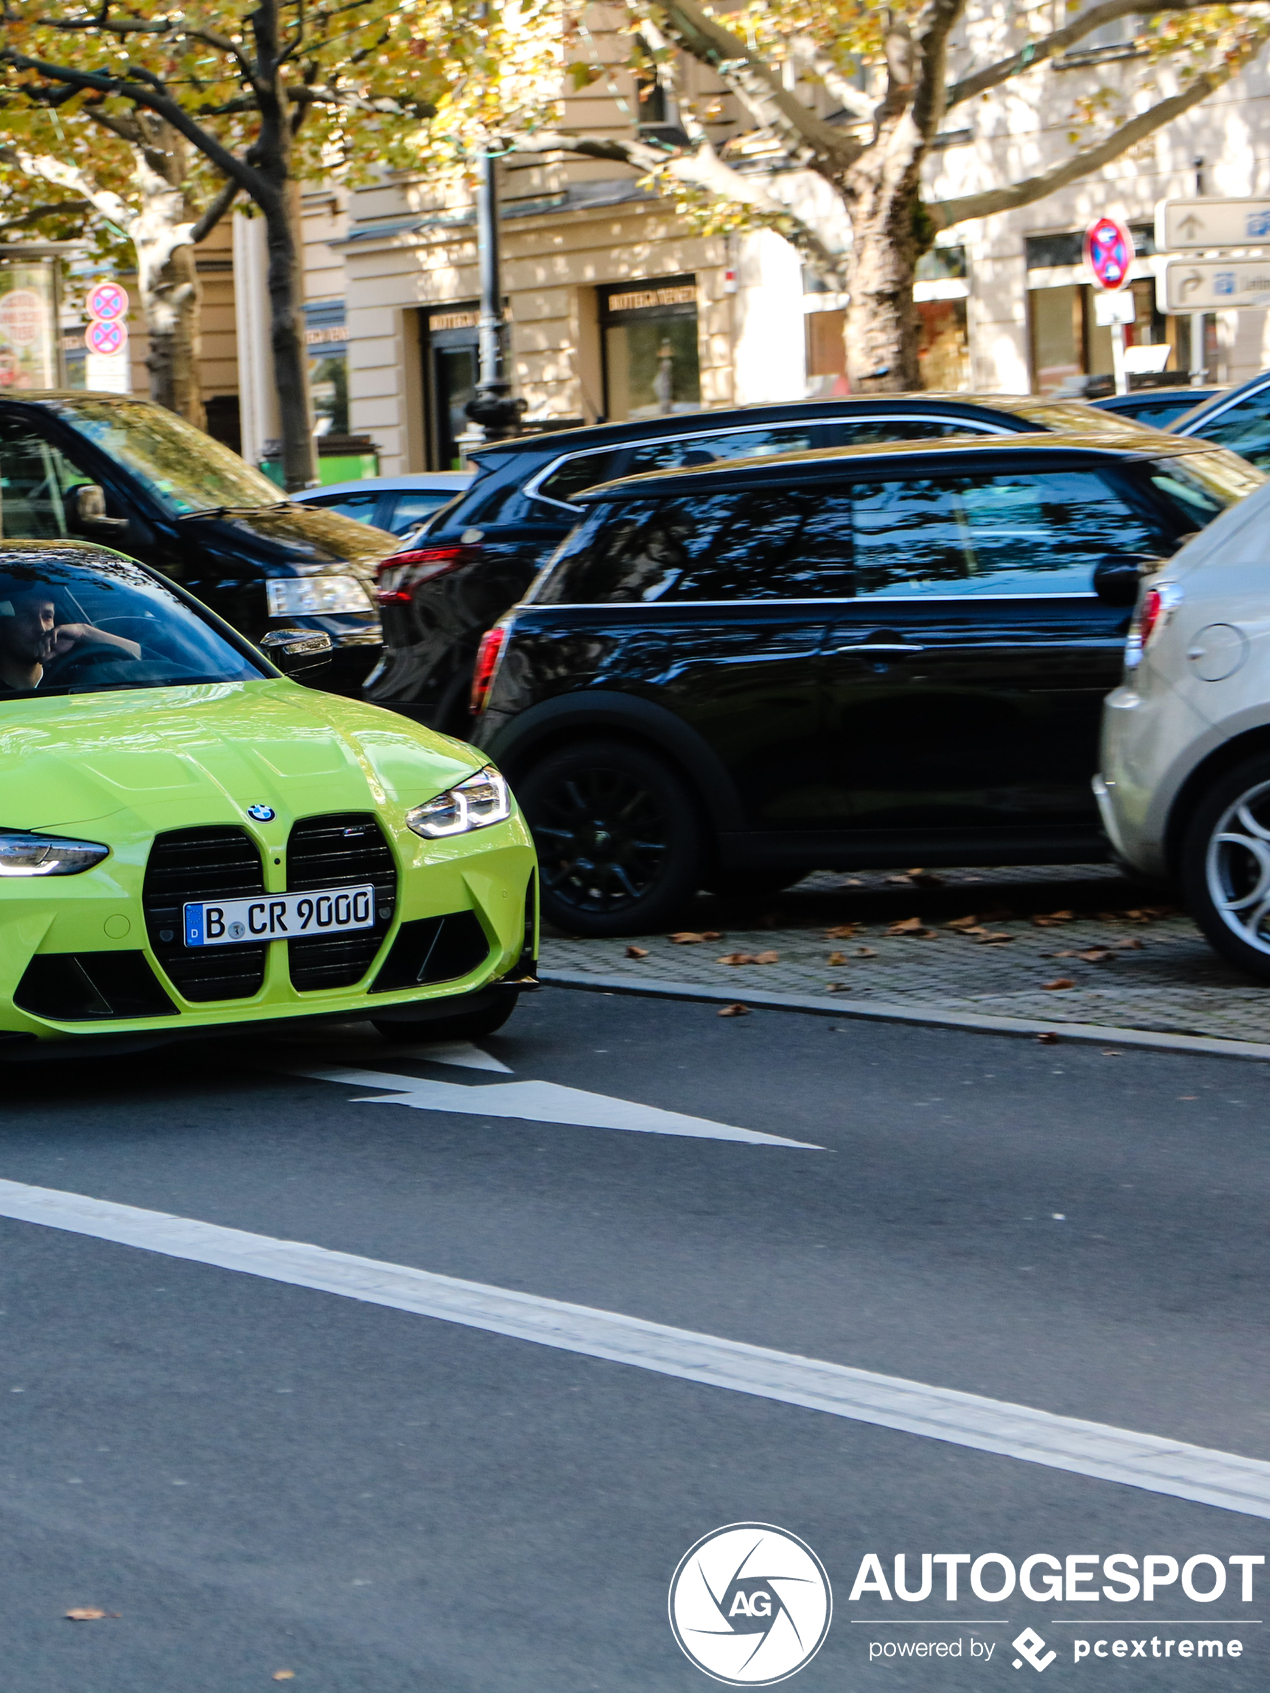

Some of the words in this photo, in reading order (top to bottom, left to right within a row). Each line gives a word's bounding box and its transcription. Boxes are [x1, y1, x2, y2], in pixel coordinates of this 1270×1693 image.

[191, 929, 199, 938] D
[206, 907, 225, 939] B
[248, 901, 288, 934] CR
[297, 891, 370, 930] 9000
